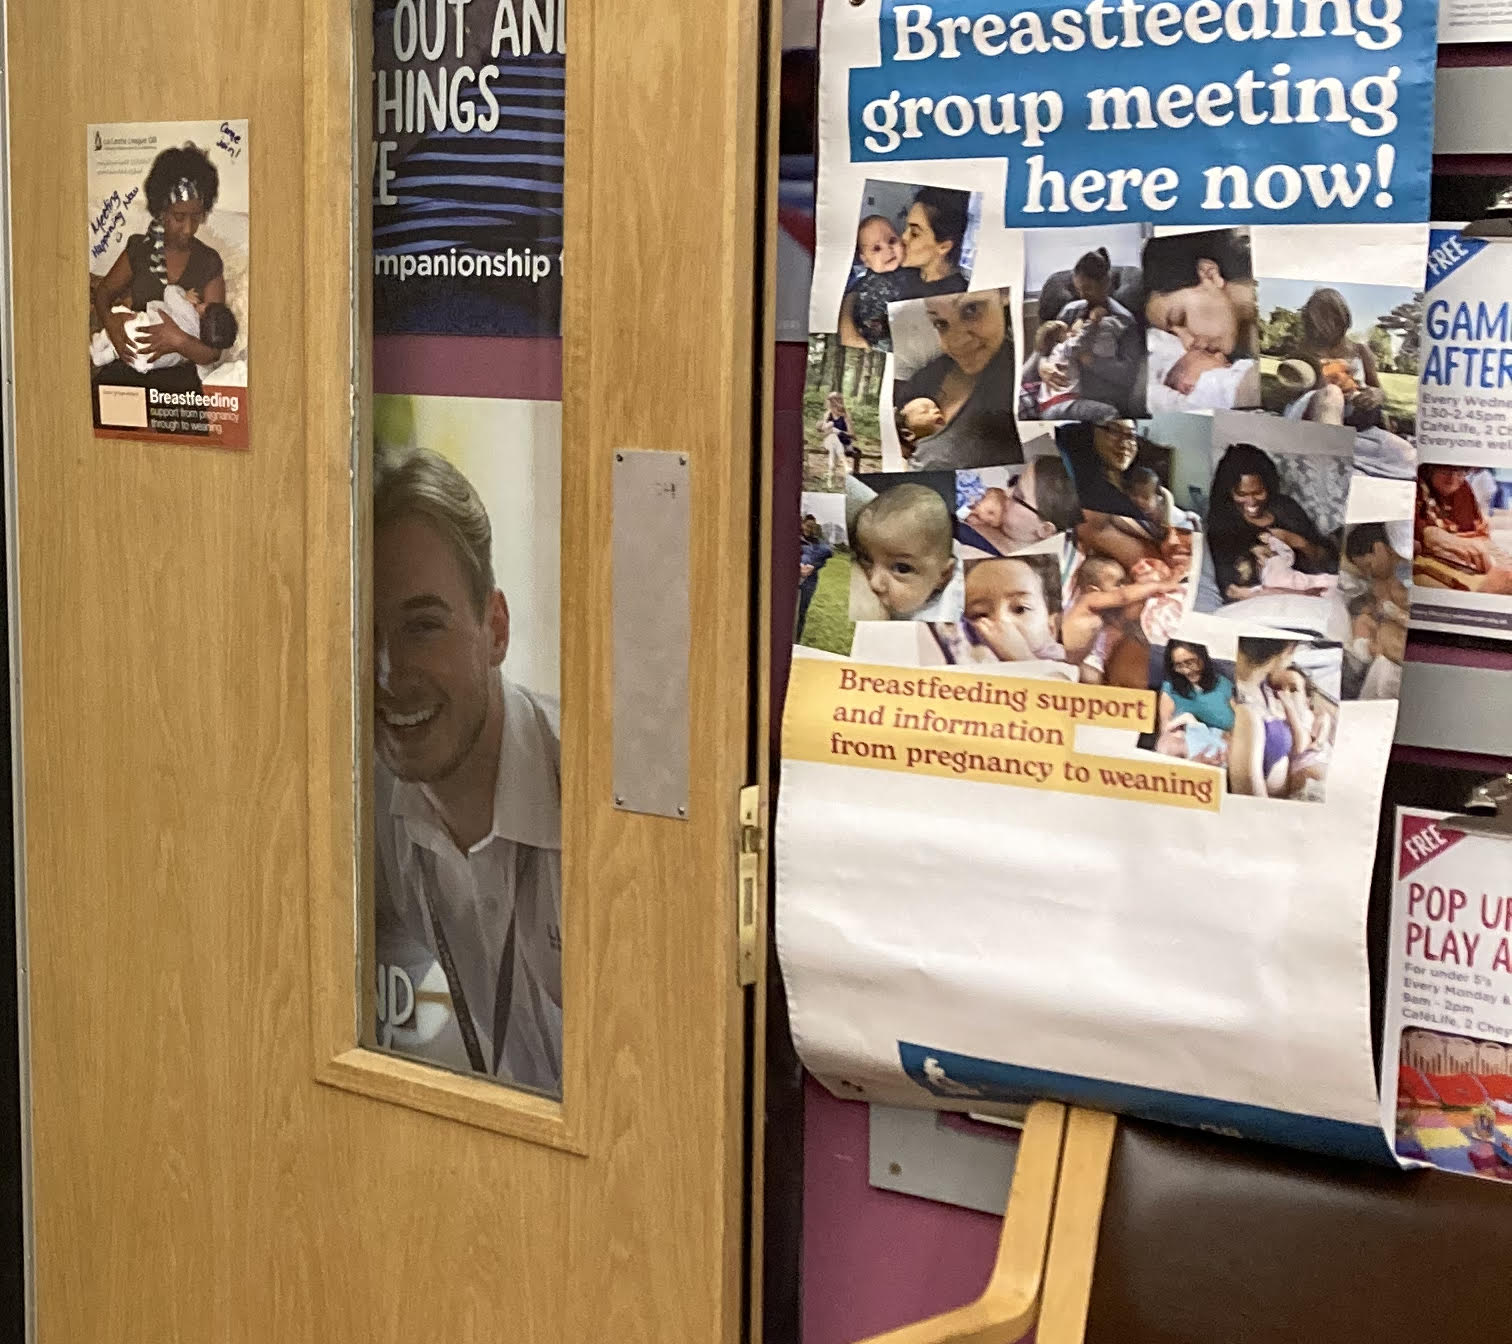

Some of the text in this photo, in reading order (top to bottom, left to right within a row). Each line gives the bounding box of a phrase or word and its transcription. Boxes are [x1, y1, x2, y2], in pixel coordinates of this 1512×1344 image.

[372, 64, 500, 134] HINGS
[861, 62, 1401, 154] group meeting
[1021, 143, 1396, 214] here now!
[1427, 234, 1470, 276] FREE
[149, 388, 239, 412] Breastfeeding
[150, 407, 240, 424] support from pregnancy
[1422, 392, 1459, 408] Every
[150, 418, 223, 434] through to weaning
[1418, 434, 1482, 449] Everyone
[1485, 425, 1493, 435] 2
[838, 668, 1148, 721] Breastfeeding support
[832, 705, 1065, 747] and information
[830, 732, 1214, 804] from pregnancy to weaning
[1404, 823, 1449, 861] FREE
[1408, 882, 1468, 924] POP
[1406, 921, 1480, 968] PLAY
[1404, 962, 1426, 974] For
[1430, 969, 1470, 982] under
[1404, 977, 1440, 994] Every
[1445, 985, 1497, 1004] Monday
[1444, 1000, 1474, 1014] 2pm
[1465, 1018, 1473, 1029] 2
